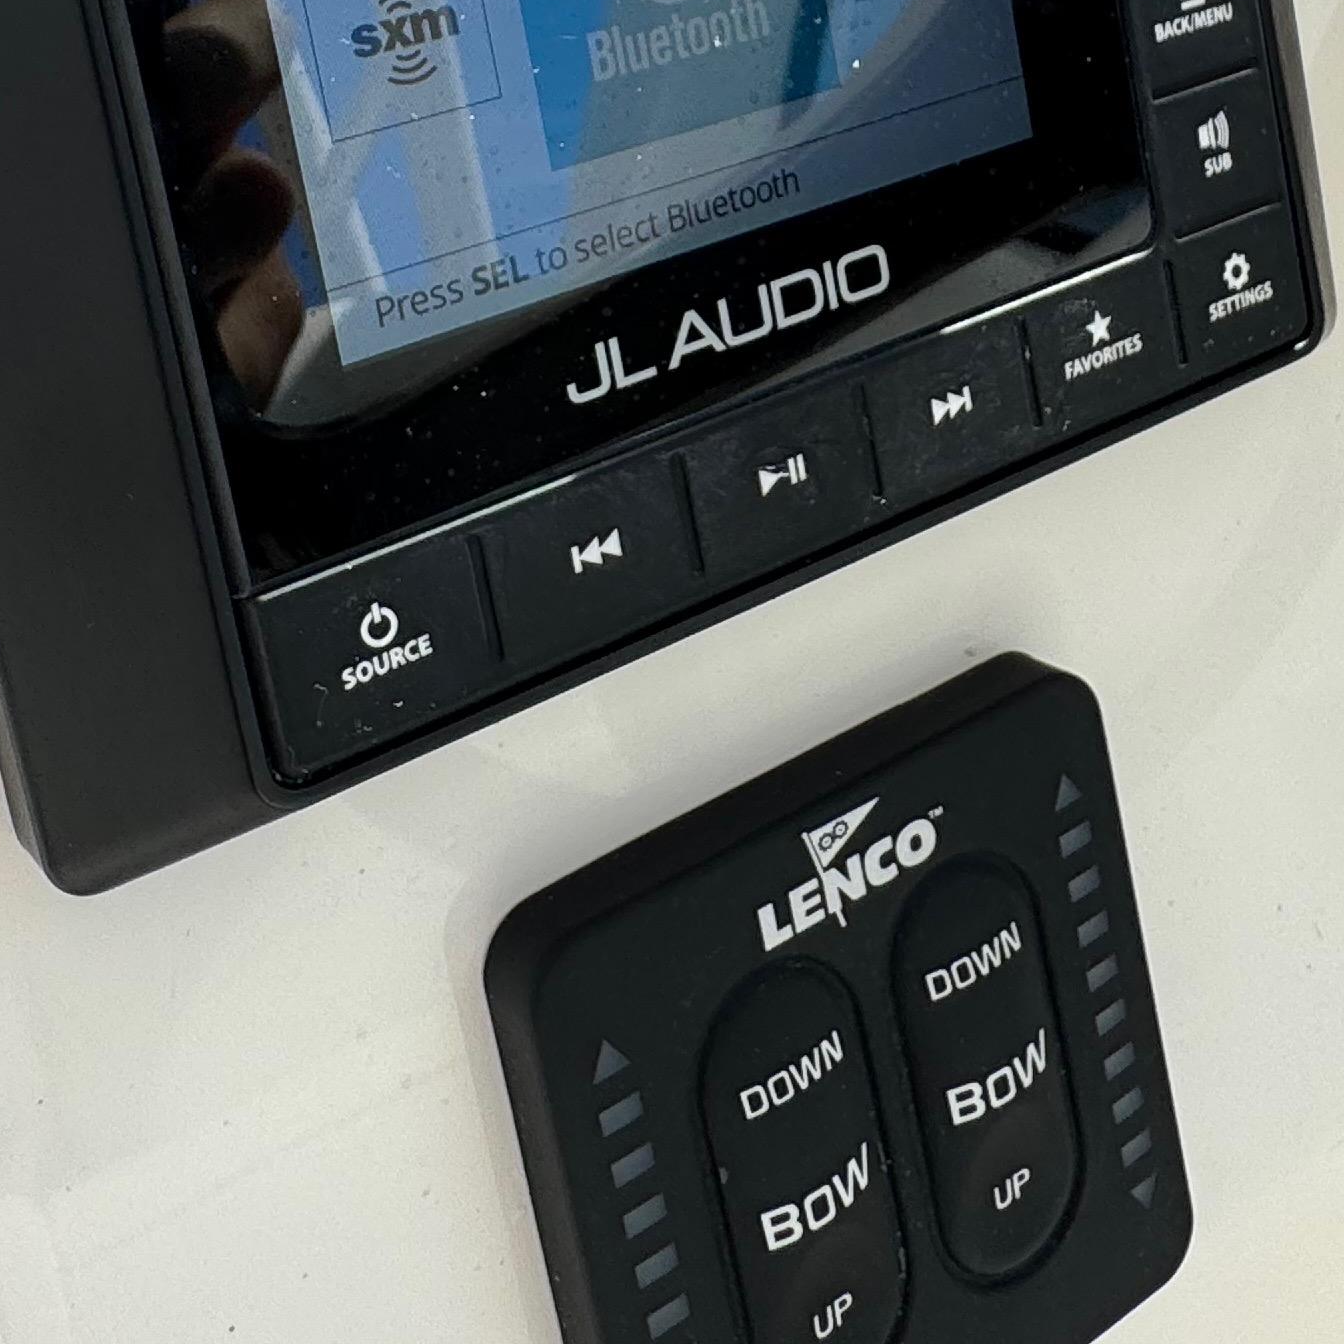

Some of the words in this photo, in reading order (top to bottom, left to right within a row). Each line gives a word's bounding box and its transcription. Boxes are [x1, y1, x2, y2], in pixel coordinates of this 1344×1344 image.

[350, 0, 460, 58] sxm
[1154, 1, 1233, 43] BACK/MENU
[1204, 152, 1233, 178] SUB
[375, 273, 464, 329] Press
[471, 256, 531, 297] SEL
[536, 245, 568, 276] to
[574, 214, 660, 263] select
[666, 168, 801, 236] Bluetooth
[566, 336, 657, 404] JL
[668, 244, 891, 371] AUDIO
[1209, 280, 1273, 323] SETTINGS
[1064, 332, 1144, 380] FAVORITES
[340, 632, 434, 692] SOURCE
[925, 922, 1022, 1002] DOWN
[739, 1030, 846, 1121] DOWN
[946, 1028, 1048, 1127] BOW
[760, 1142, 870, 1252] BOW
[993, 1167, 1032, 1212] UP
[812, 1292, 854, 1342] UP
